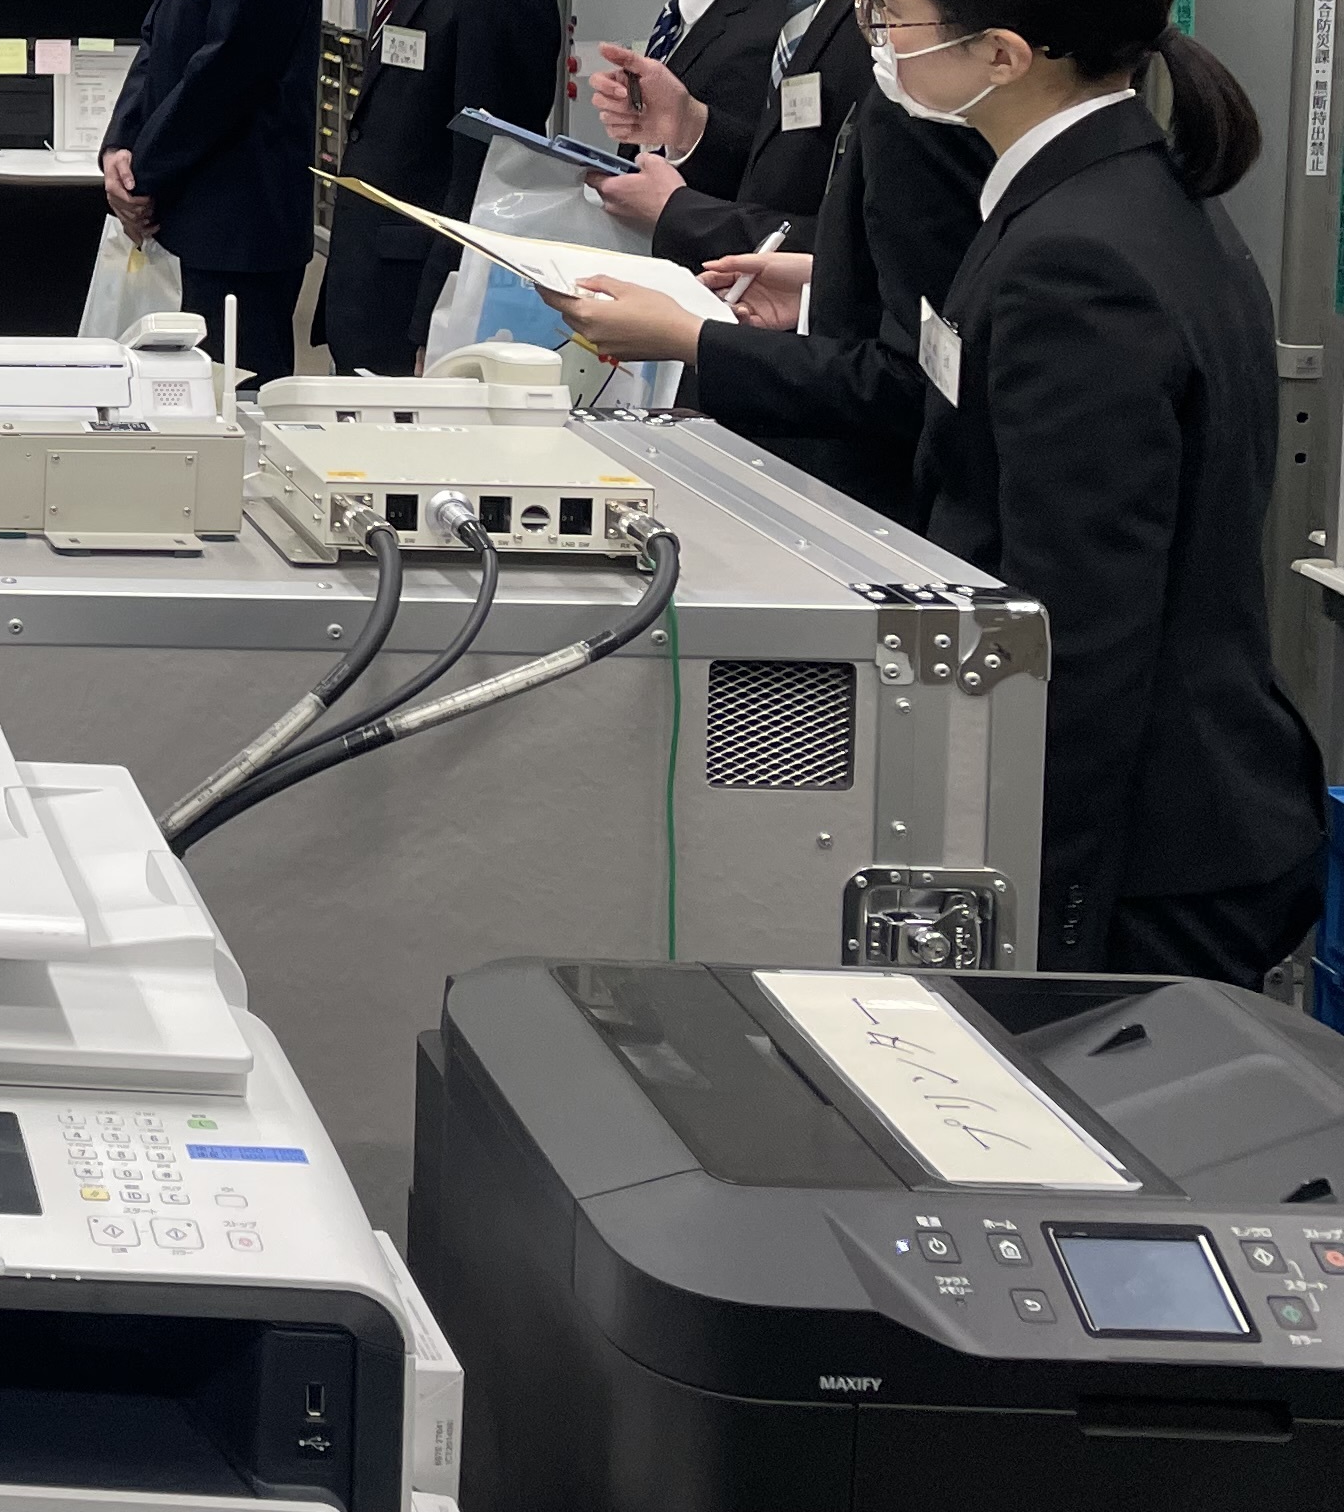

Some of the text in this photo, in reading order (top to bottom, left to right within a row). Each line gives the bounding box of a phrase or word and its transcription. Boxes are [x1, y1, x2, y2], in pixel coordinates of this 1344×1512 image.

[853, 998, 1032, 1152] プリンター
[819, 1375, 883, 1392] MAXIFY
